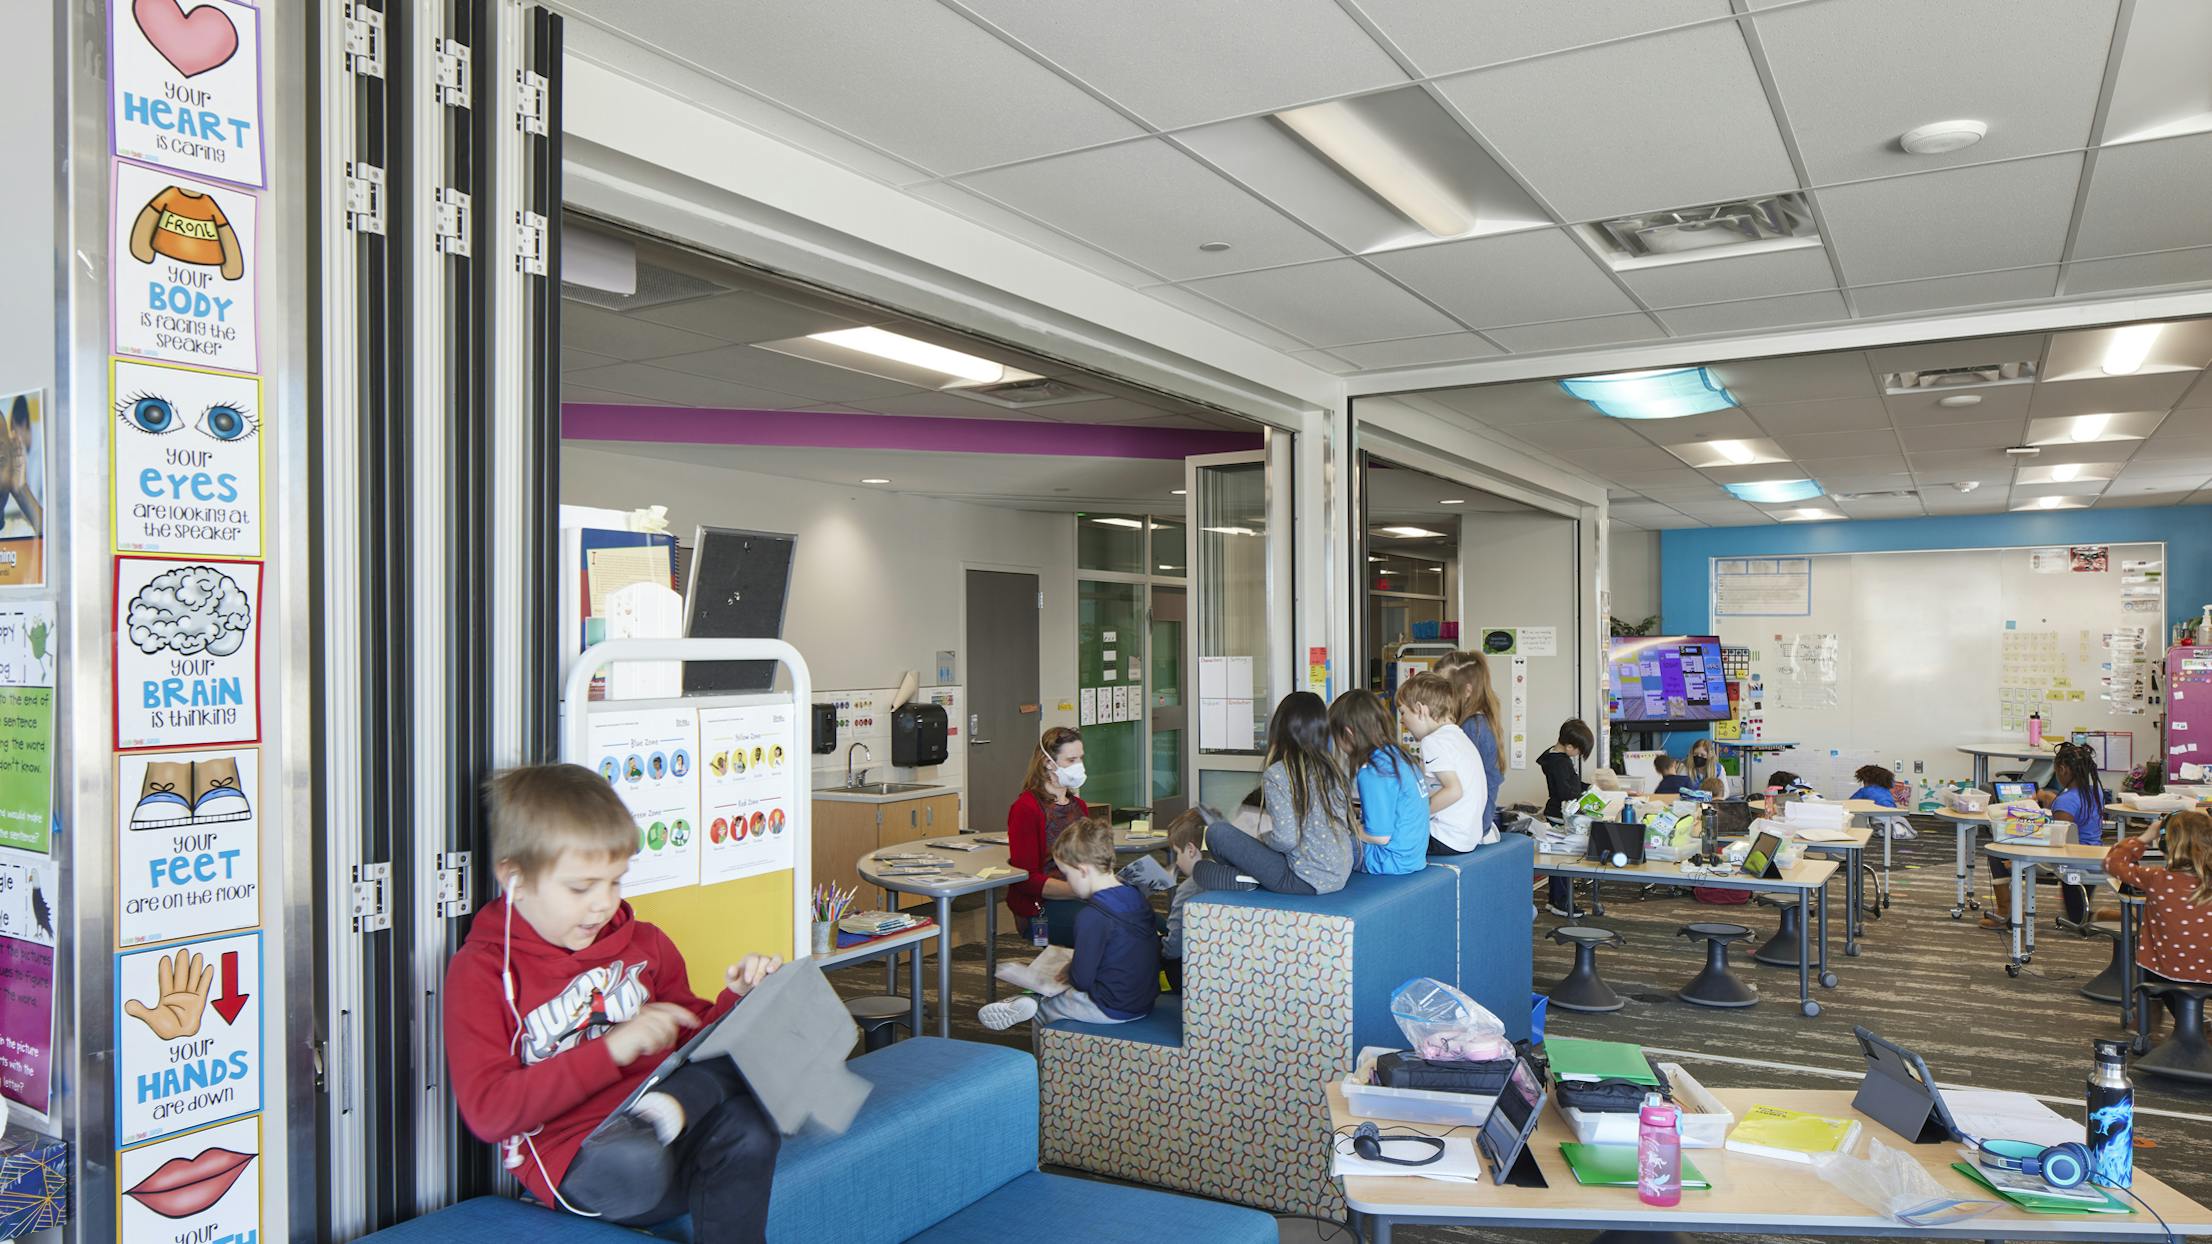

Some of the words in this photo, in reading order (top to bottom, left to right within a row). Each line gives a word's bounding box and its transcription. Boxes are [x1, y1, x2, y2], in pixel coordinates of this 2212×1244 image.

[165, 81, 211, 108] your
[157, 135, 168, 150] is
[172, 138, 225, 163] caring
[168, 266, 213, 289] your
[149, 282, 233, 322] BODY
[141, 312, 152, 328] is
[156, 313, 206, 336] facing
[210, 322, 236, 341] the
[156, 333, 222, 356] speaker
[166, 448, 212, 468] your
[133, 502, 165, 519] are
[168, 504, 226, 525] looking
[229, 508, 250, 524] at
[144, 522, 171, 538] the
[174, 524, 241, 541] speaker
[170, 658, 215, 676] your
[151, 711, 164, 728] is
[168, 707, 236, 727] thinking
[173, 831, 217, 854] your
[126, 896, 160, 915] are
[163, 892, 184, 908] on
[186, 887, 212, 906] the
[215, 883, 256, 902] floor
[170, 1036, 214, 1064] your
[137, 1050, 249, 1104] HANDS
[152, 1099, 185, 1121] are
[187, 1086, 234, 1113] down
